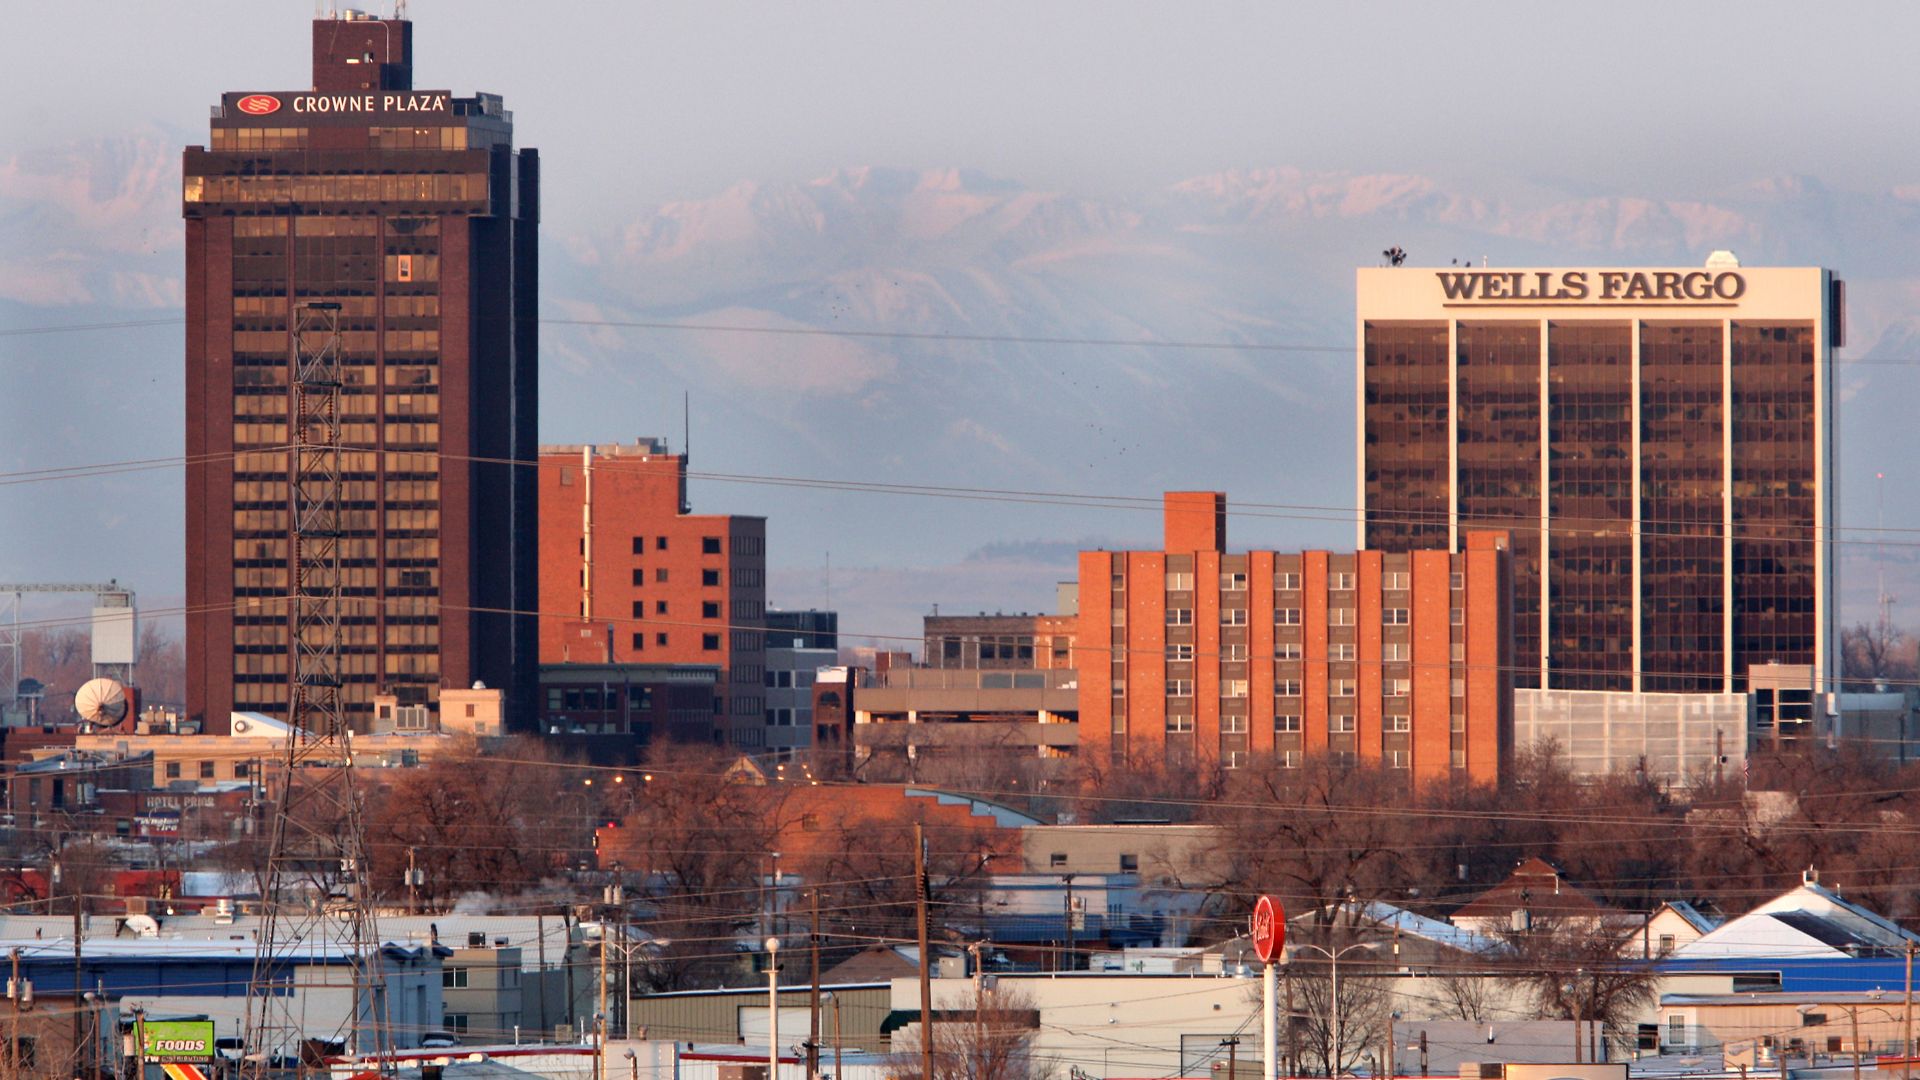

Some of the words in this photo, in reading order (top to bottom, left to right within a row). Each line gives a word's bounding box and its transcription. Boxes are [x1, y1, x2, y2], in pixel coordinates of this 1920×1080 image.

[293, 95, 374, 113] CROWNE
[383, 95, 446, 112] PLAZA
[1436, 271, 1590, 300] WELLS
[1598, 271, 1746, 300] FARGO
[156, 1040, 206, 1051] FOODS
